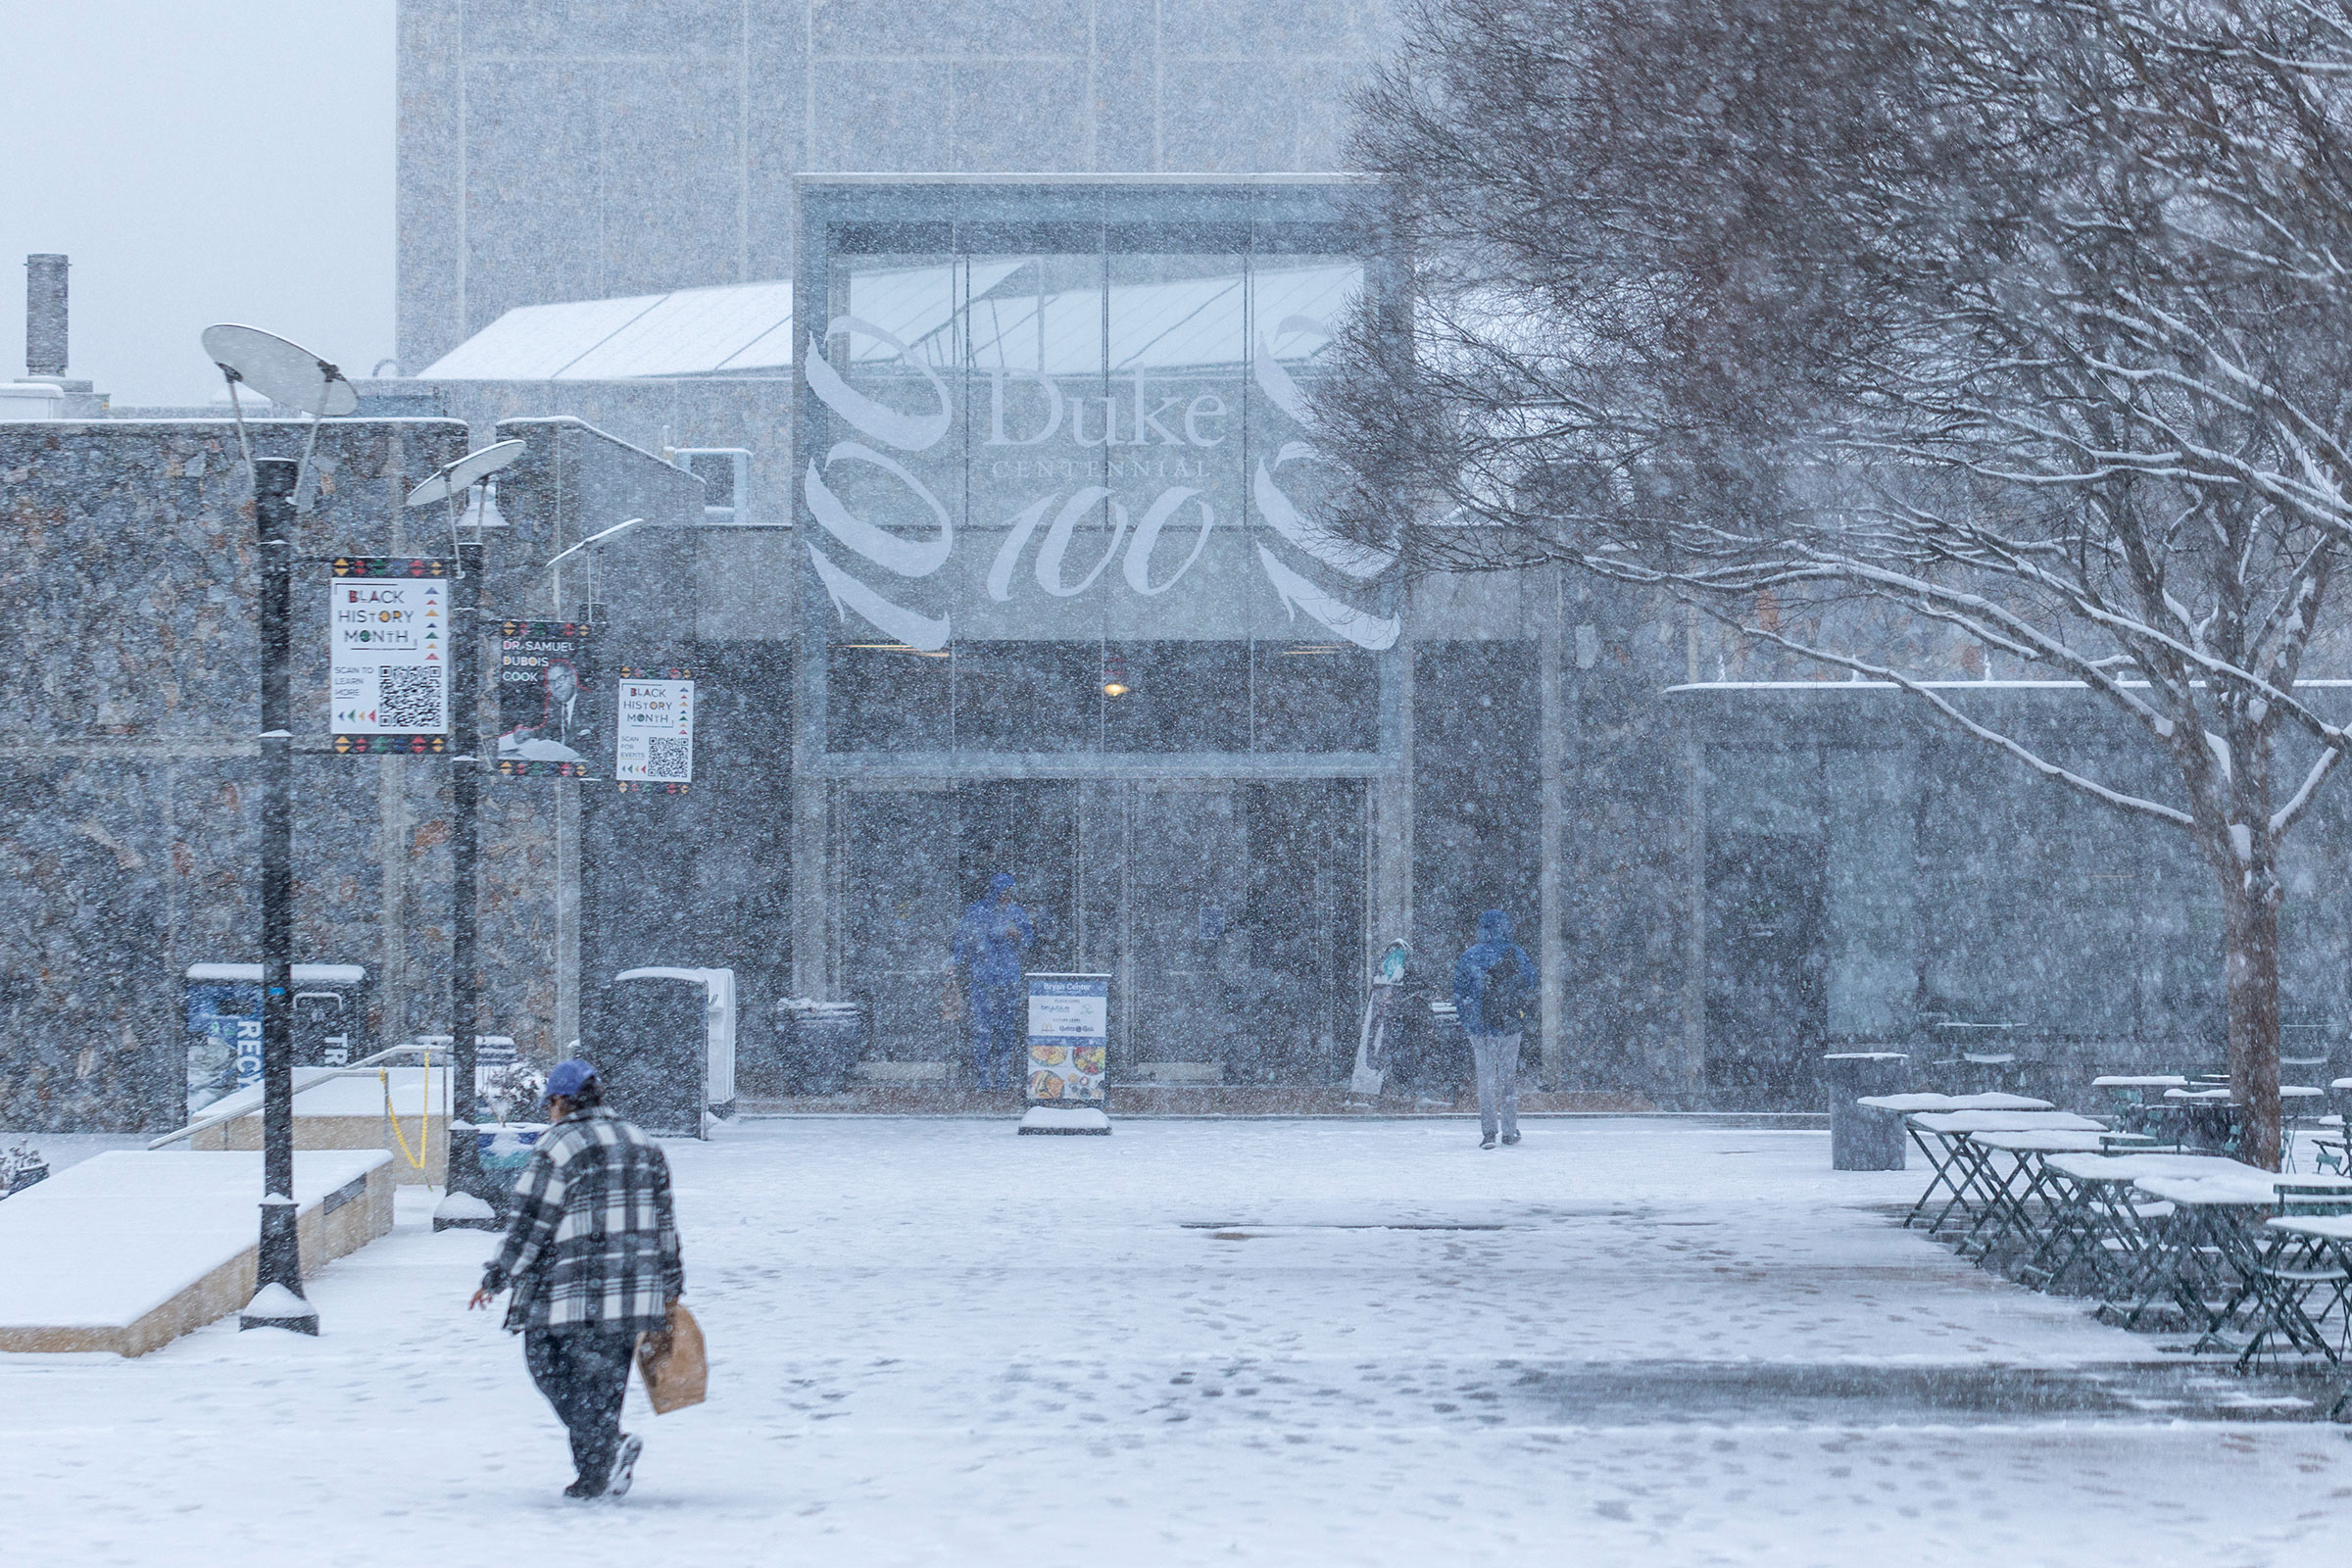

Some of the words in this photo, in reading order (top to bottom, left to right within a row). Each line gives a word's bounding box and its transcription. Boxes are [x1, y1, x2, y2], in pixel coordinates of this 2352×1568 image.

[982, 362, 1227, 447] Duke
[992, 460, 1211, 478] CENTENNIAL
[987, 486, 1215, 602] 100
[348, 590, 405, 604] BLACK
[338, 610, 415, 623] HISTORY
[344, 629, 408, 643] MONTH
[525, 640, 575, 652] SAMUEL
[503, 657, 549, 667] DUBOIS
[503, 671, 538, 682] COOK
[334, 688, 361, 697] MORE
[630, 688, 666, 698] BLACK
[623, 701, 672, 710] HISTORY
[627, 713, 668, 723] MONTH
[1044, 983, 1065, 992] Bryan
